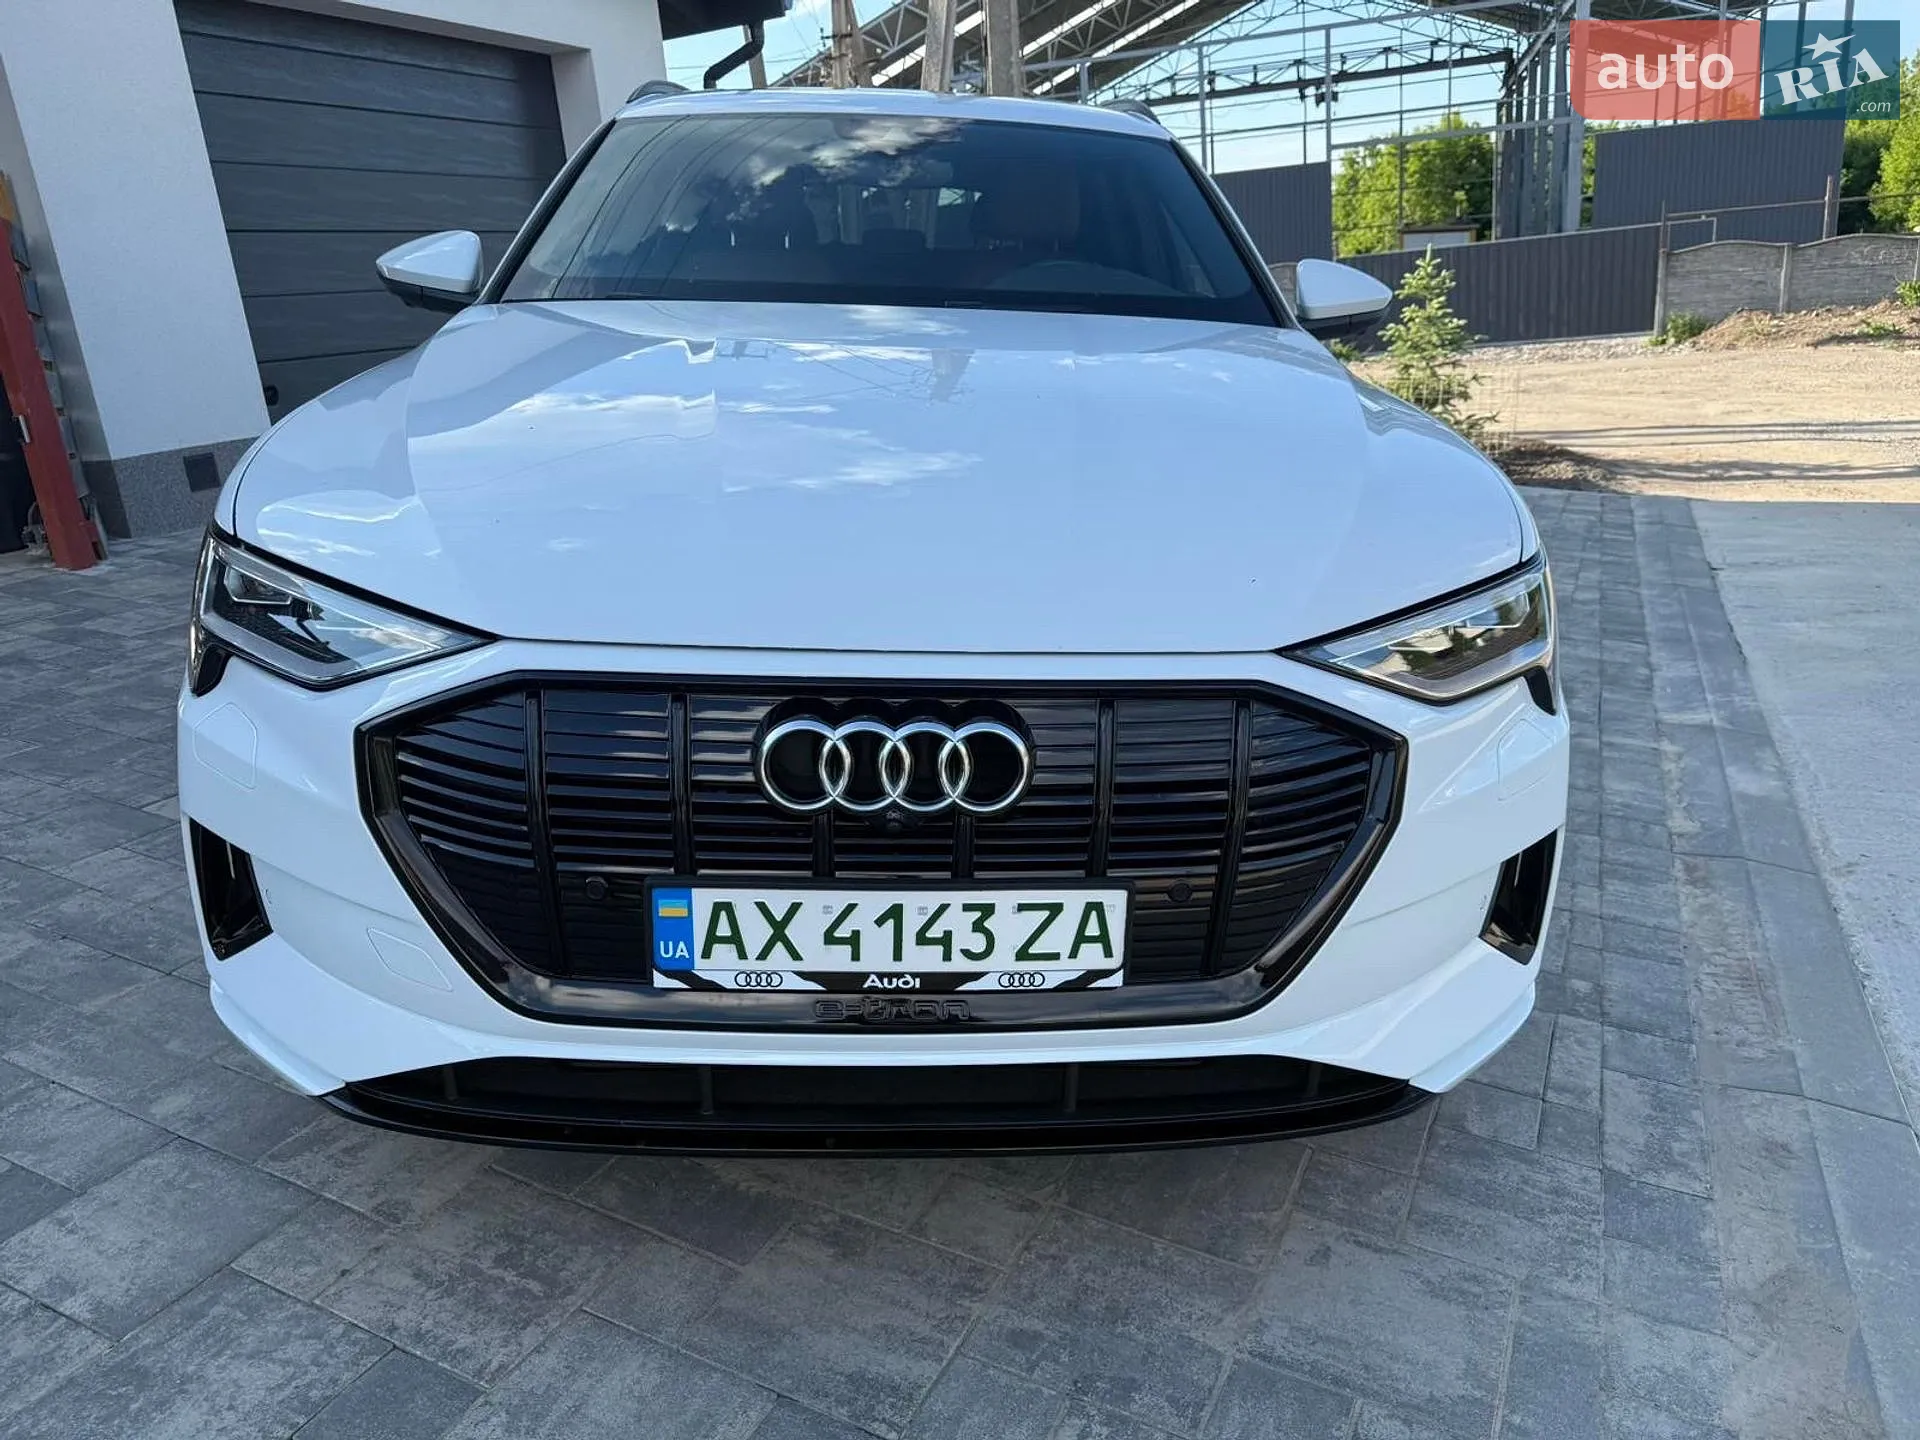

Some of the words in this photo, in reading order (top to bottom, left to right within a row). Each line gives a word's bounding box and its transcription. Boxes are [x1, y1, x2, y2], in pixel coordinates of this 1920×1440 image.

[700, 900, 804, 962] AX
[822, 902, 996, 962] 4143
[1014, 901, 1114, 962] ZA
[660, 940, 690, 959] UA
[862, 973, 921, 989] Audi
